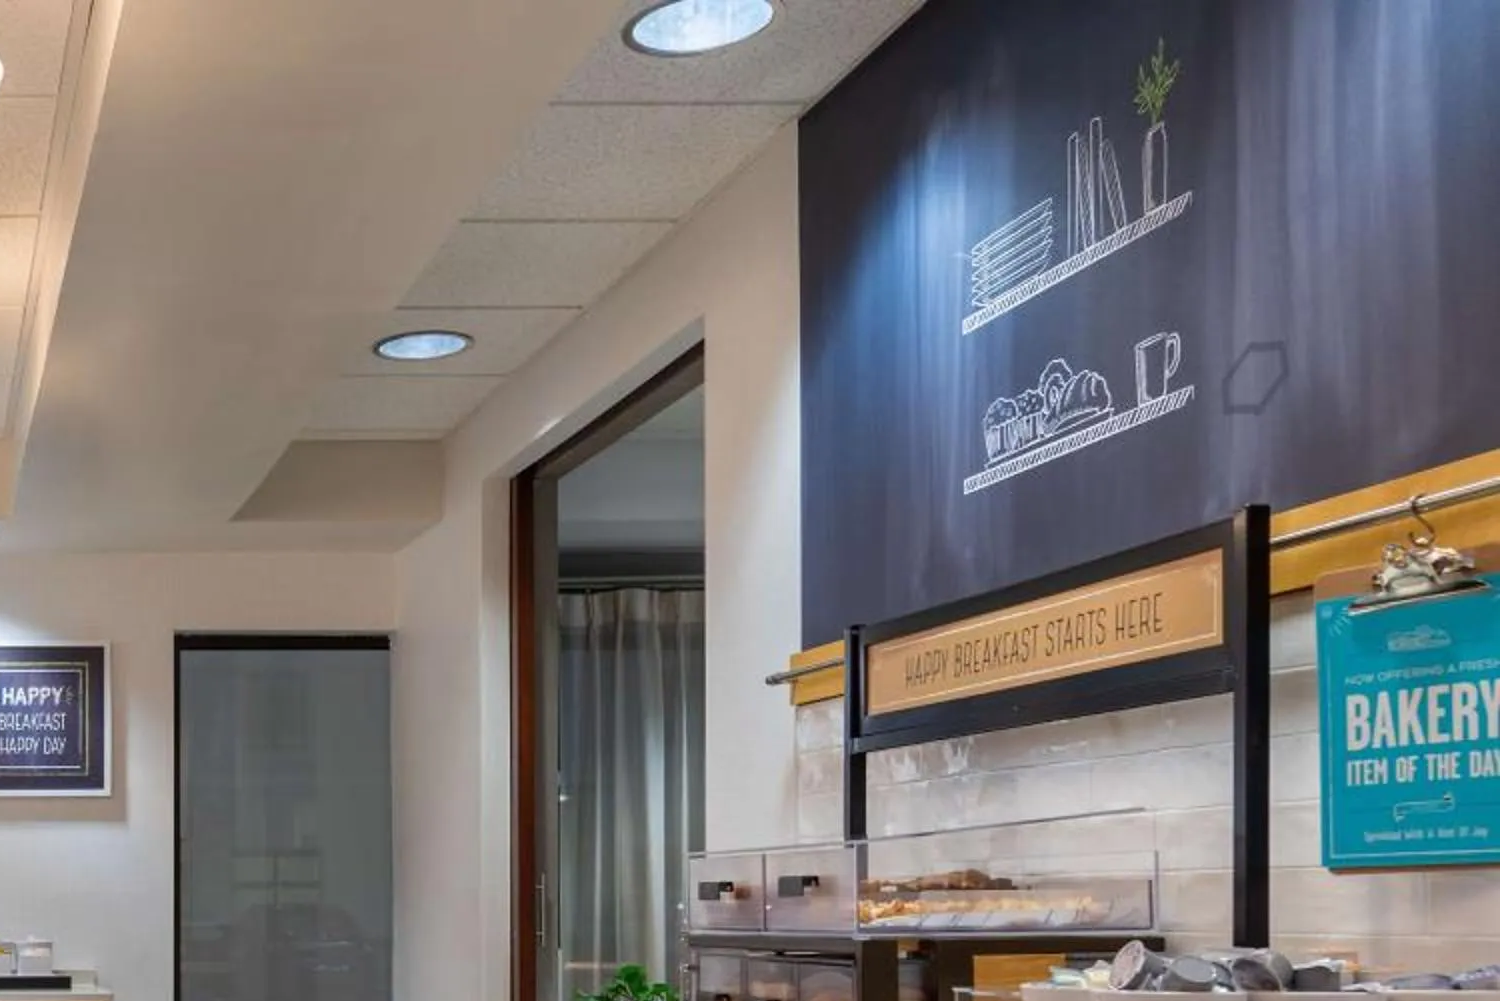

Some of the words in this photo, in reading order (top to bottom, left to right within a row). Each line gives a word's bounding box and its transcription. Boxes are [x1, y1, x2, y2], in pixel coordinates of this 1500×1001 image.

[905, 648, 949, 689] HAPPY
[954, 624, 1039, 678] BREAKFAST
[1045, 608, 1107, 657] STARTS
[1115, 592, 1163, 641] HERE
[1, 686, 64, 706] HAPPY
[0, 712, 67, 731] BREAKFAST
[1346, 678, 1500, 751] BAKERY
[0, 737, 41, 755] HAPPY
[43, 737, 67, 755] DAY
[1346, 759, 1388, 787] ITEM
[1395, 756, 1419, 783] OF
[1424, 752, 1461, 780] THE
